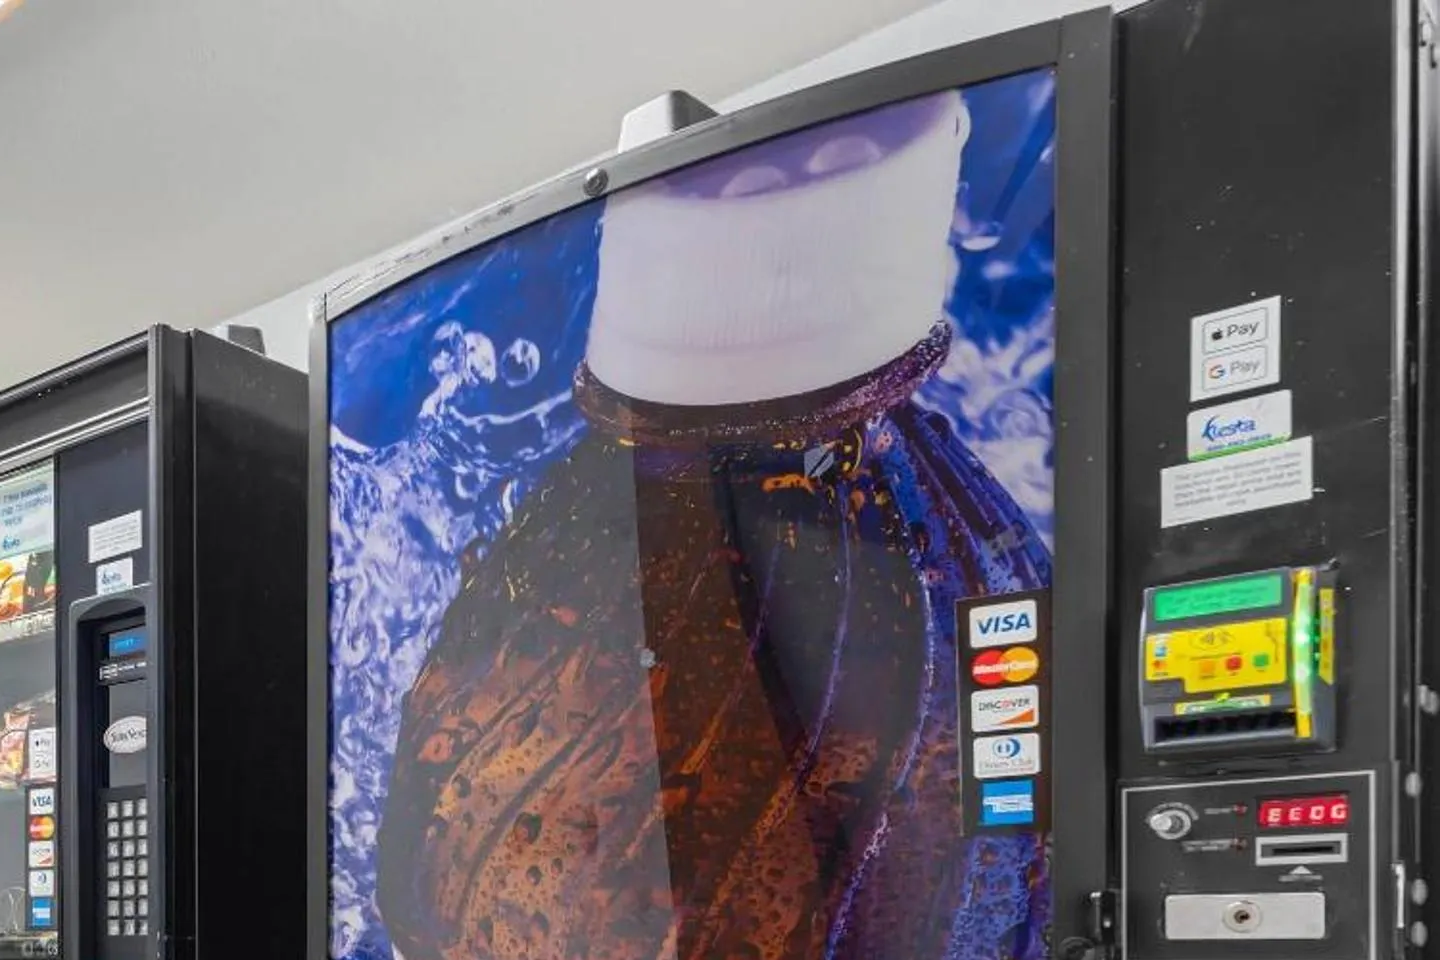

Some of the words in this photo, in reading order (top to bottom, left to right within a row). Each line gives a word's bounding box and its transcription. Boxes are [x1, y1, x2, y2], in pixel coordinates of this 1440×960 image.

[1226, 321, 1260, 338] Pay
[1230, 358, 1260, 375] Pay
[977, 612, 1032, 635] VISA
